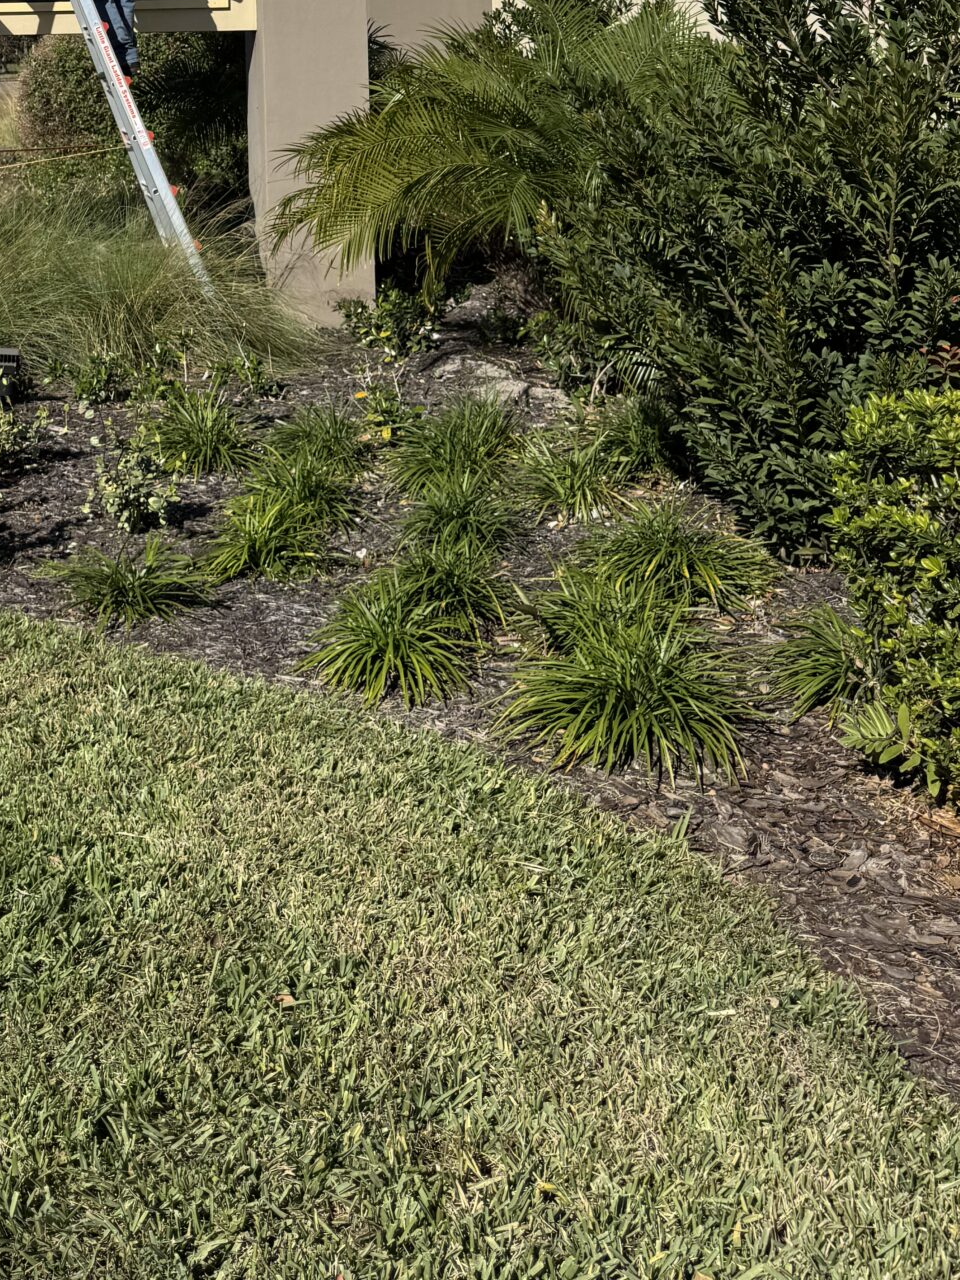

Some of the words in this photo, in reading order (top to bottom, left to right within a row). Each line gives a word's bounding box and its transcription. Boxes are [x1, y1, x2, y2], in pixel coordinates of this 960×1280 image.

[103, 45, 115, 65] Giant
[112, 64, 125, 88] Ladder
[121, 89, 137, 119] Systems
